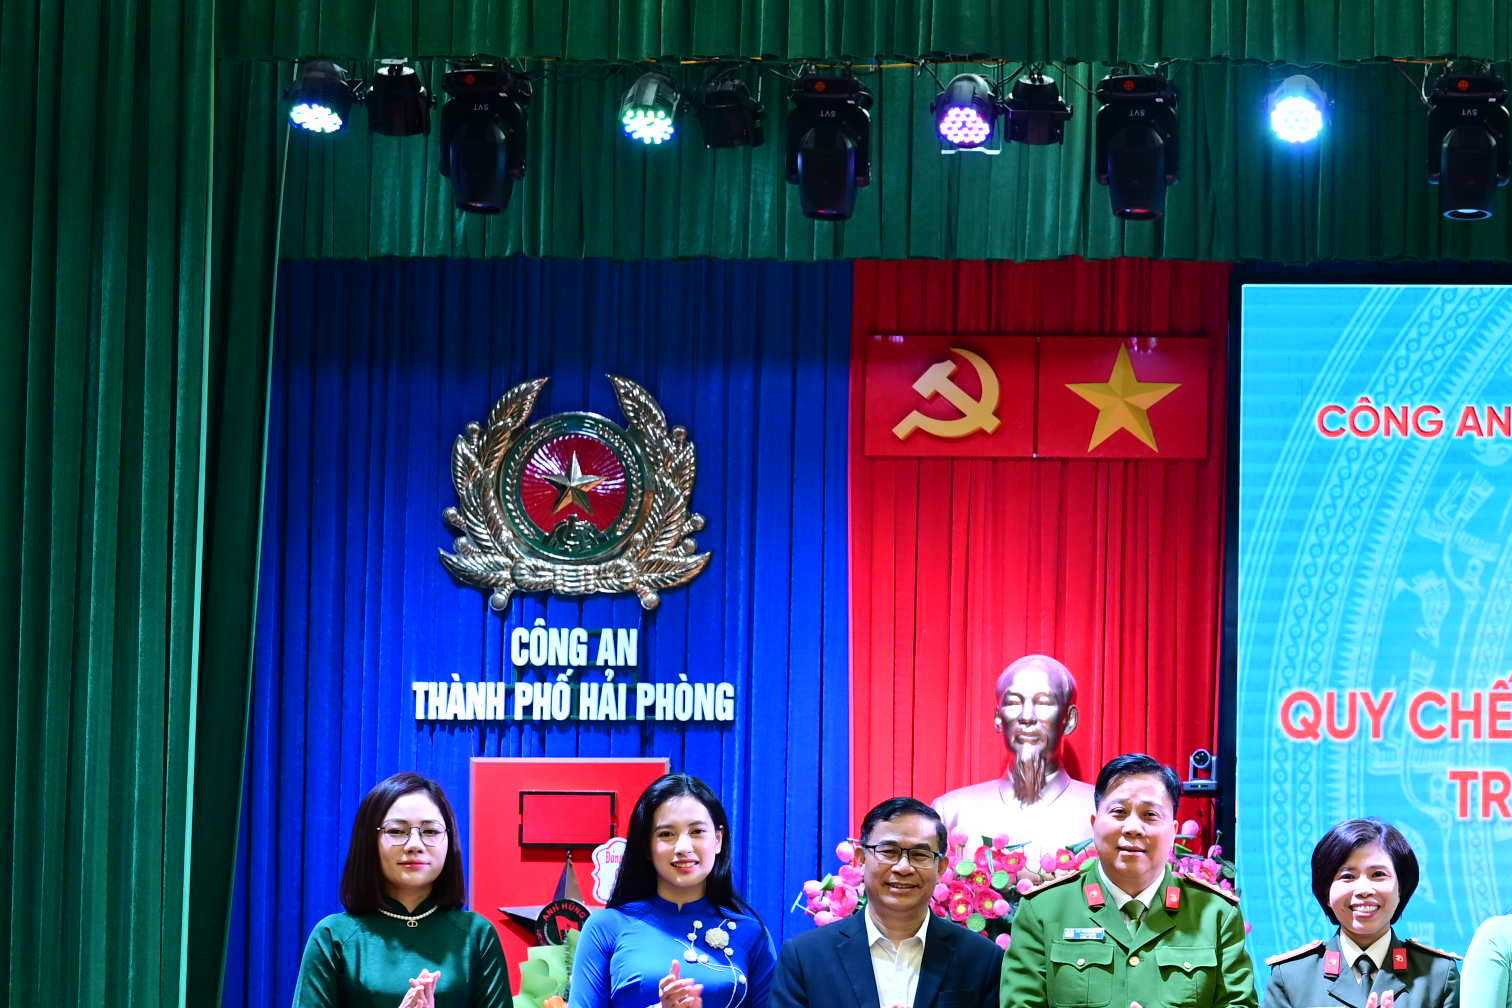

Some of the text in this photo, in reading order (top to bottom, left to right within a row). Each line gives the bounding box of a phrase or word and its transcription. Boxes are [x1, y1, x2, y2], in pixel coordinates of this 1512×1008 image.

[1317, 397, 1443, 438] CÔNG
[1455, 406, 1511, 437] AN
[510, 618, 638, 667] CÔNG AN
[412, 669, 735, 722] THÀNH PHỐ HẢI PHÒNG
[1280, 690, 1394, 741] QUY
